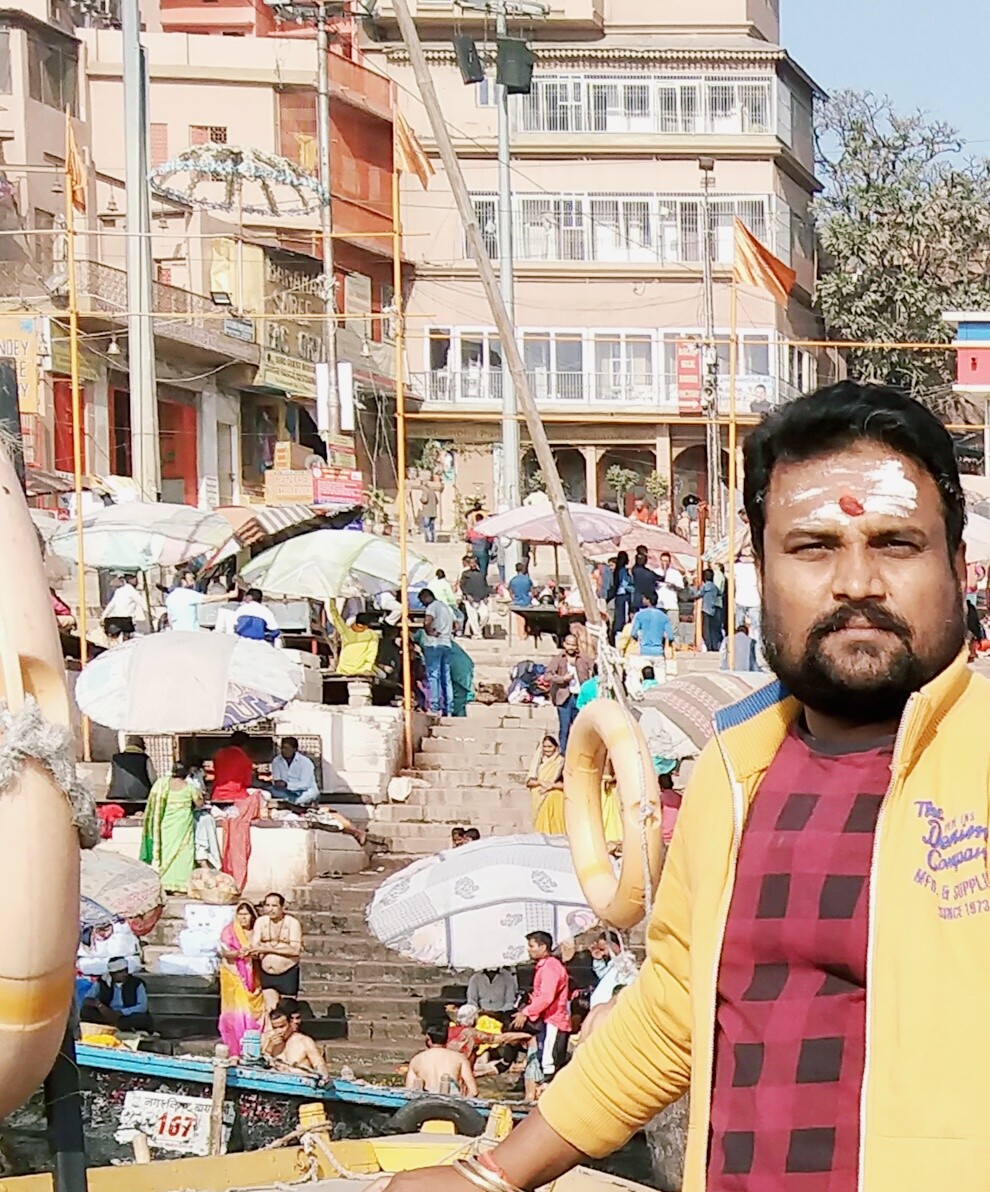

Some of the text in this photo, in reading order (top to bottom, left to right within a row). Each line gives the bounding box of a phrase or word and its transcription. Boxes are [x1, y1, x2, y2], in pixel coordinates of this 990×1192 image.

[914, 800, 944, 820] The
[938, 899, 990, 920] SINCE 1973
[158, 1112, 194, 1137] 167
